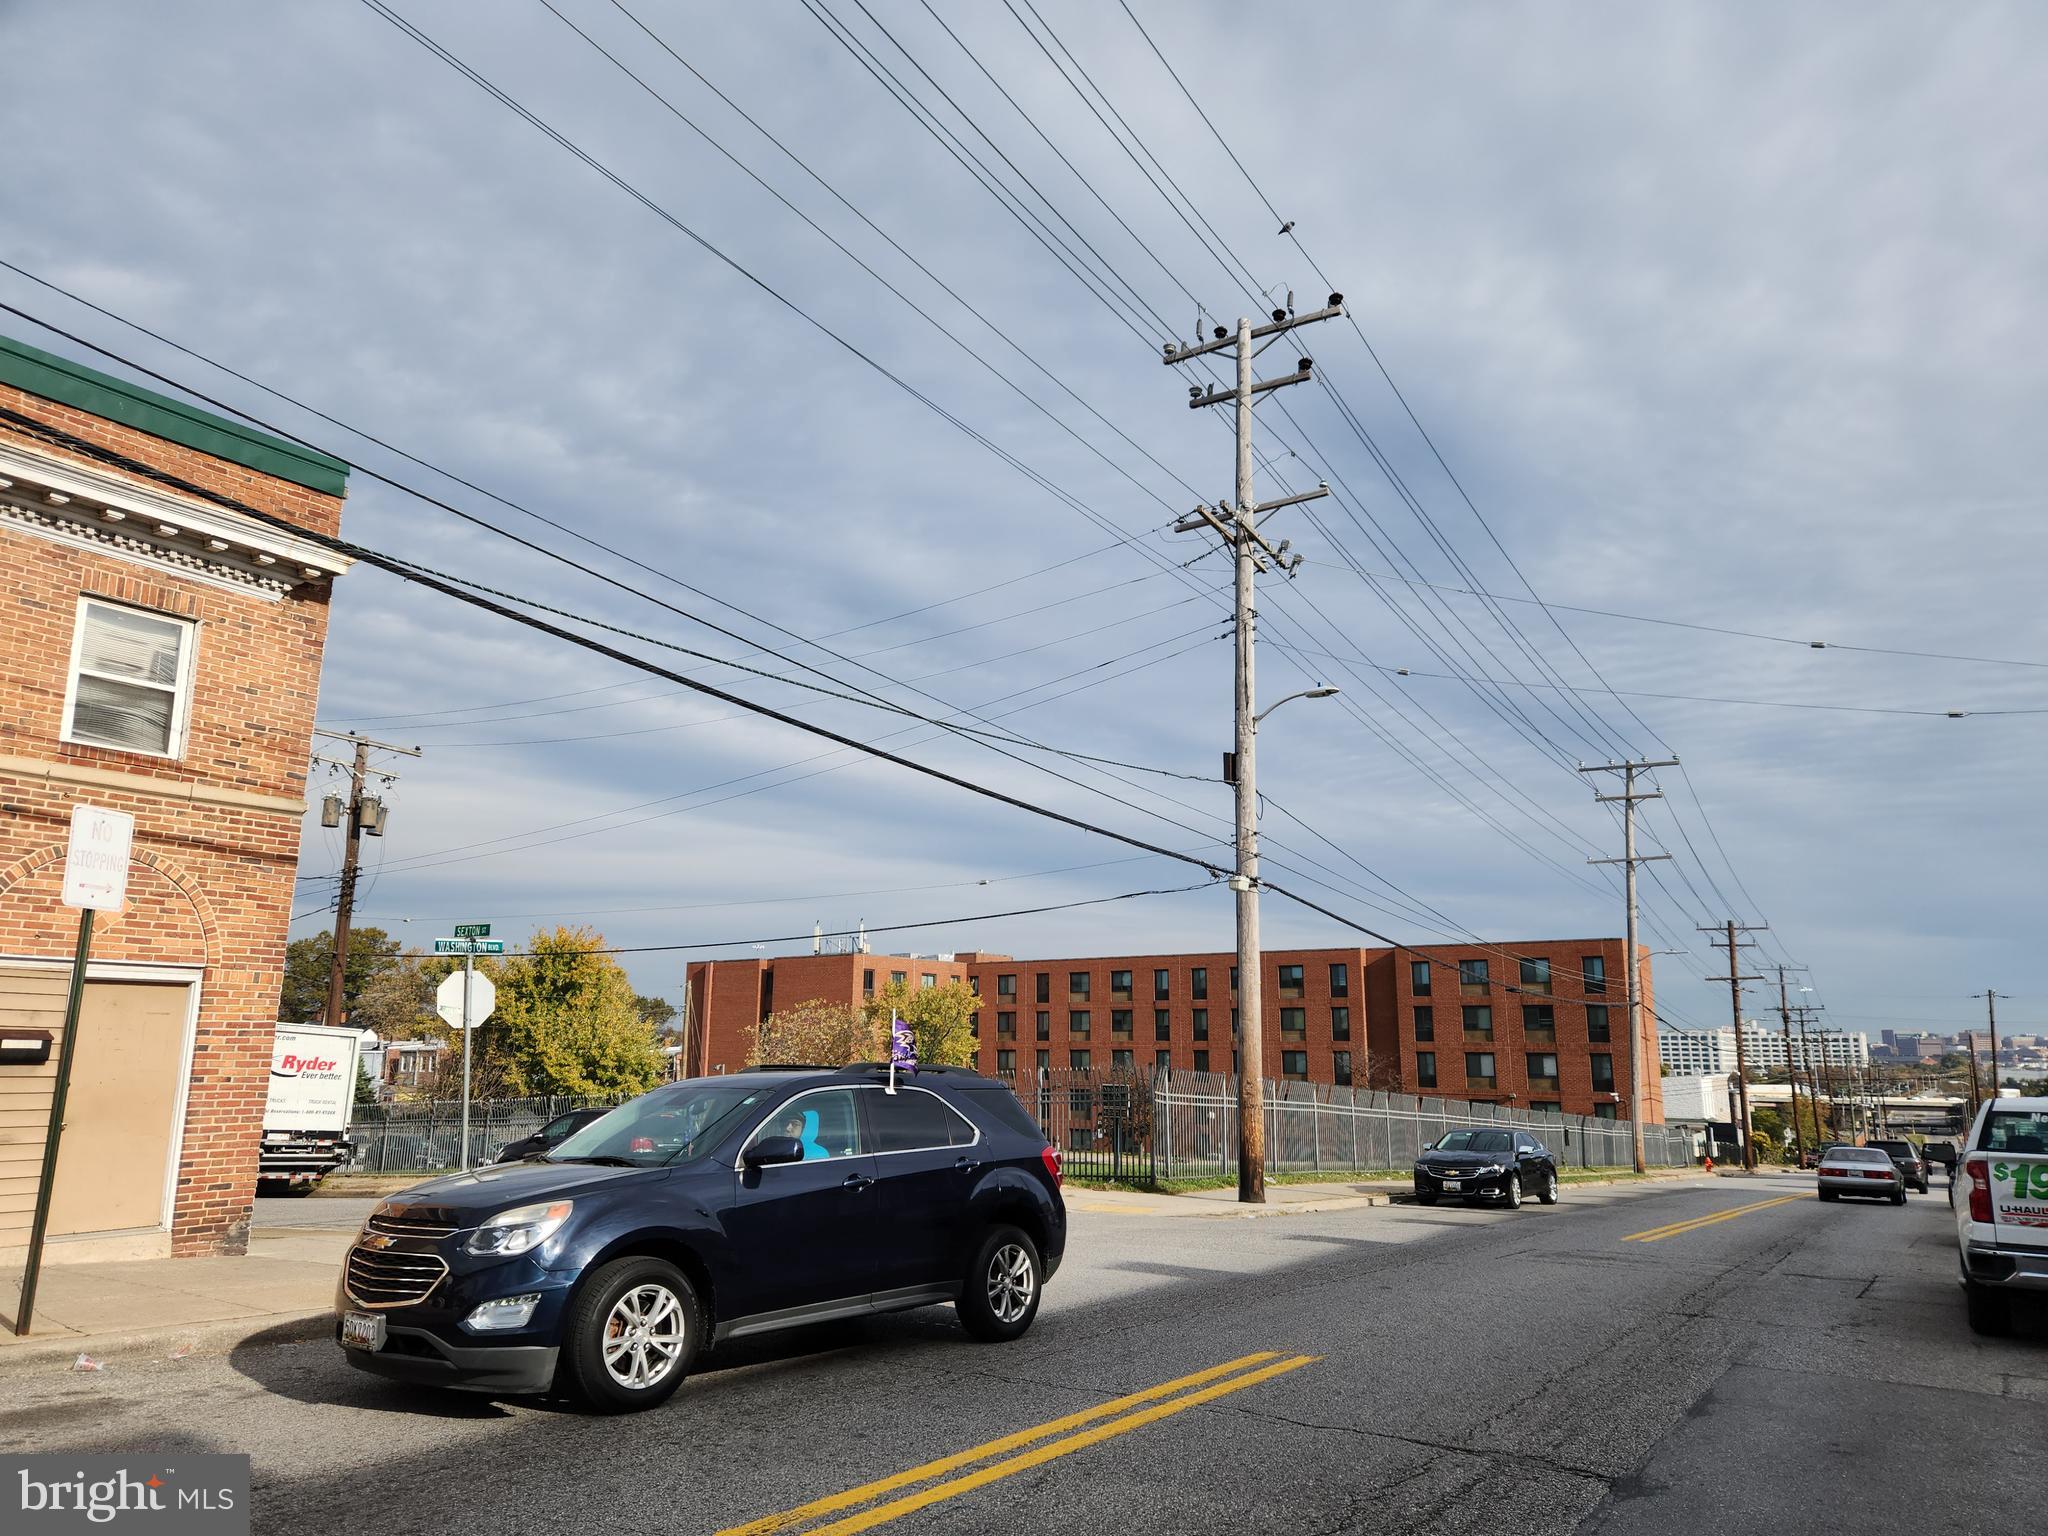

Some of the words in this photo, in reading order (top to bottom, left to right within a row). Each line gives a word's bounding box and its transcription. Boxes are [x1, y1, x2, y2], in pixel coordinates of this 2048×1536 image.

[92, 821, 113, 842] NO
[73, 849, 124, 873] STOPPING
[457, 926, 480, 936] SEXTON
[438, 941, 488, 953] WASHINGTON
[281, 1055, 337, 1073] Ryder
